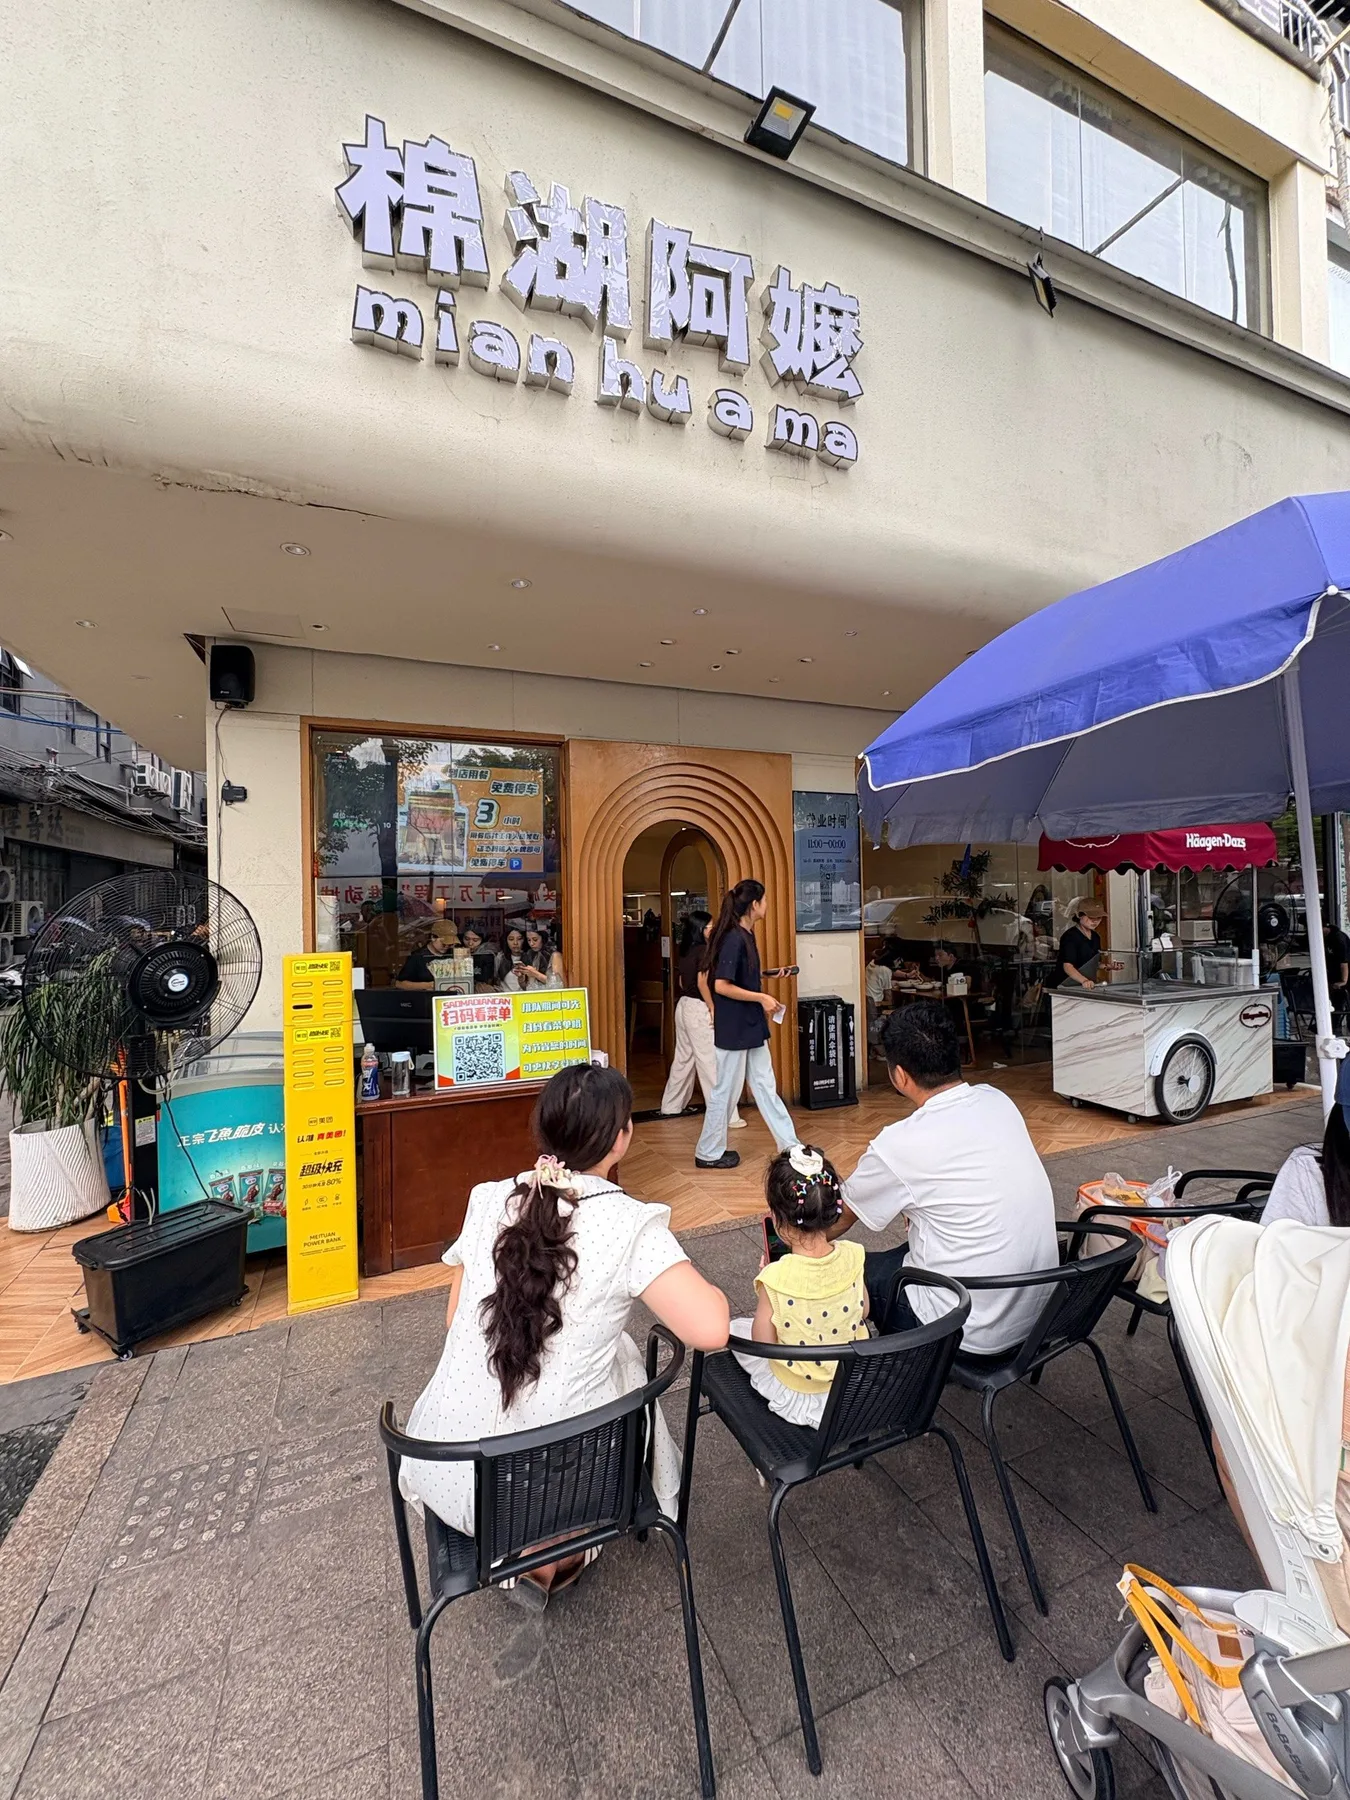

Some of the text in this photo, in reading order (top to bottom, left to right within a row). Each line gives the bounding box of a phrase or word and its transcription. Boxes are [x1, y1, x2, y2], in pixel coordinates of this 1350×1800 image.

[335, 114, 864, 402] 棉湖阿嬷
[353, 285, 859, 465] mian hu a ma
[490, 781, 538, 796] 免费停车
[476, 799, 498, 826] 3
[503, 816, 521, 826] 小时
[806, 813, 847, 829] 营业时间
[442, 1007, 512, 1027] 扫码看菜单
[828, 1015, 837, 1067] 请使用伞袋机
[303, 1236, 342, 1248] POWER BANK
